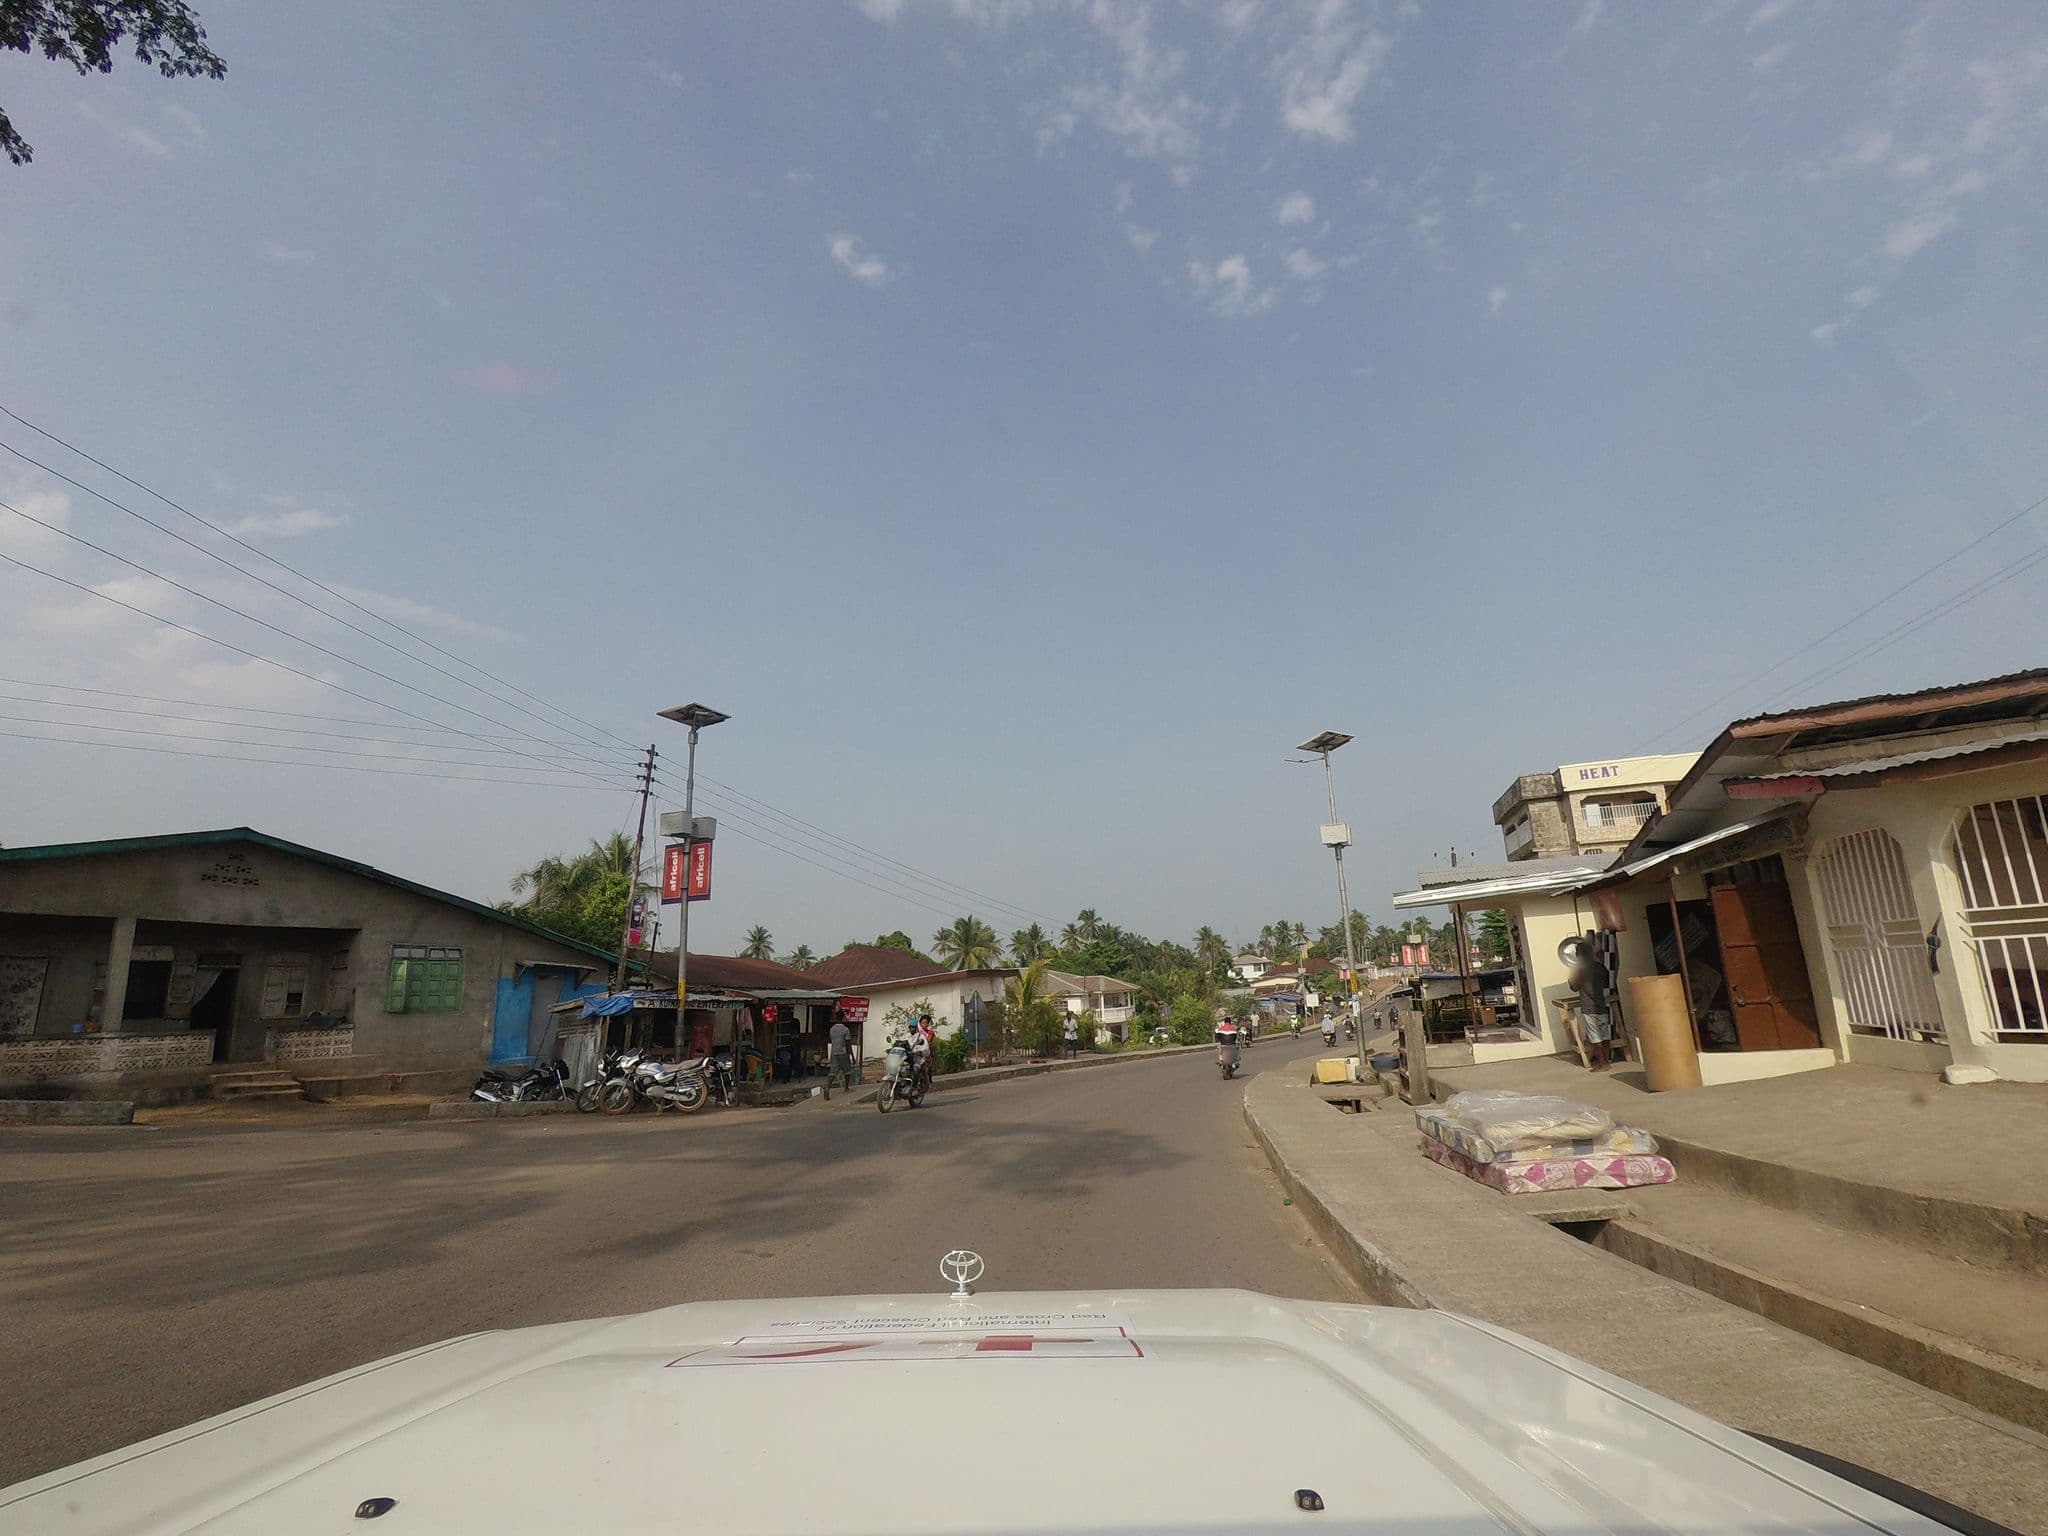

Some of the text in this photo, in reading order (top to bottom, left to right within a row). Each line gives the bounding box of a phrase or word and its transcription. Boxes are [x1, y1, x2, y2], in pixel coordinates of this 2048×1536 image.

[1579, 765, 1619, 780] HEAT
[669, 851, 679, 892] africell
[695, 847, 706, 889] africell
[817, 1324, 836, 1332] of
